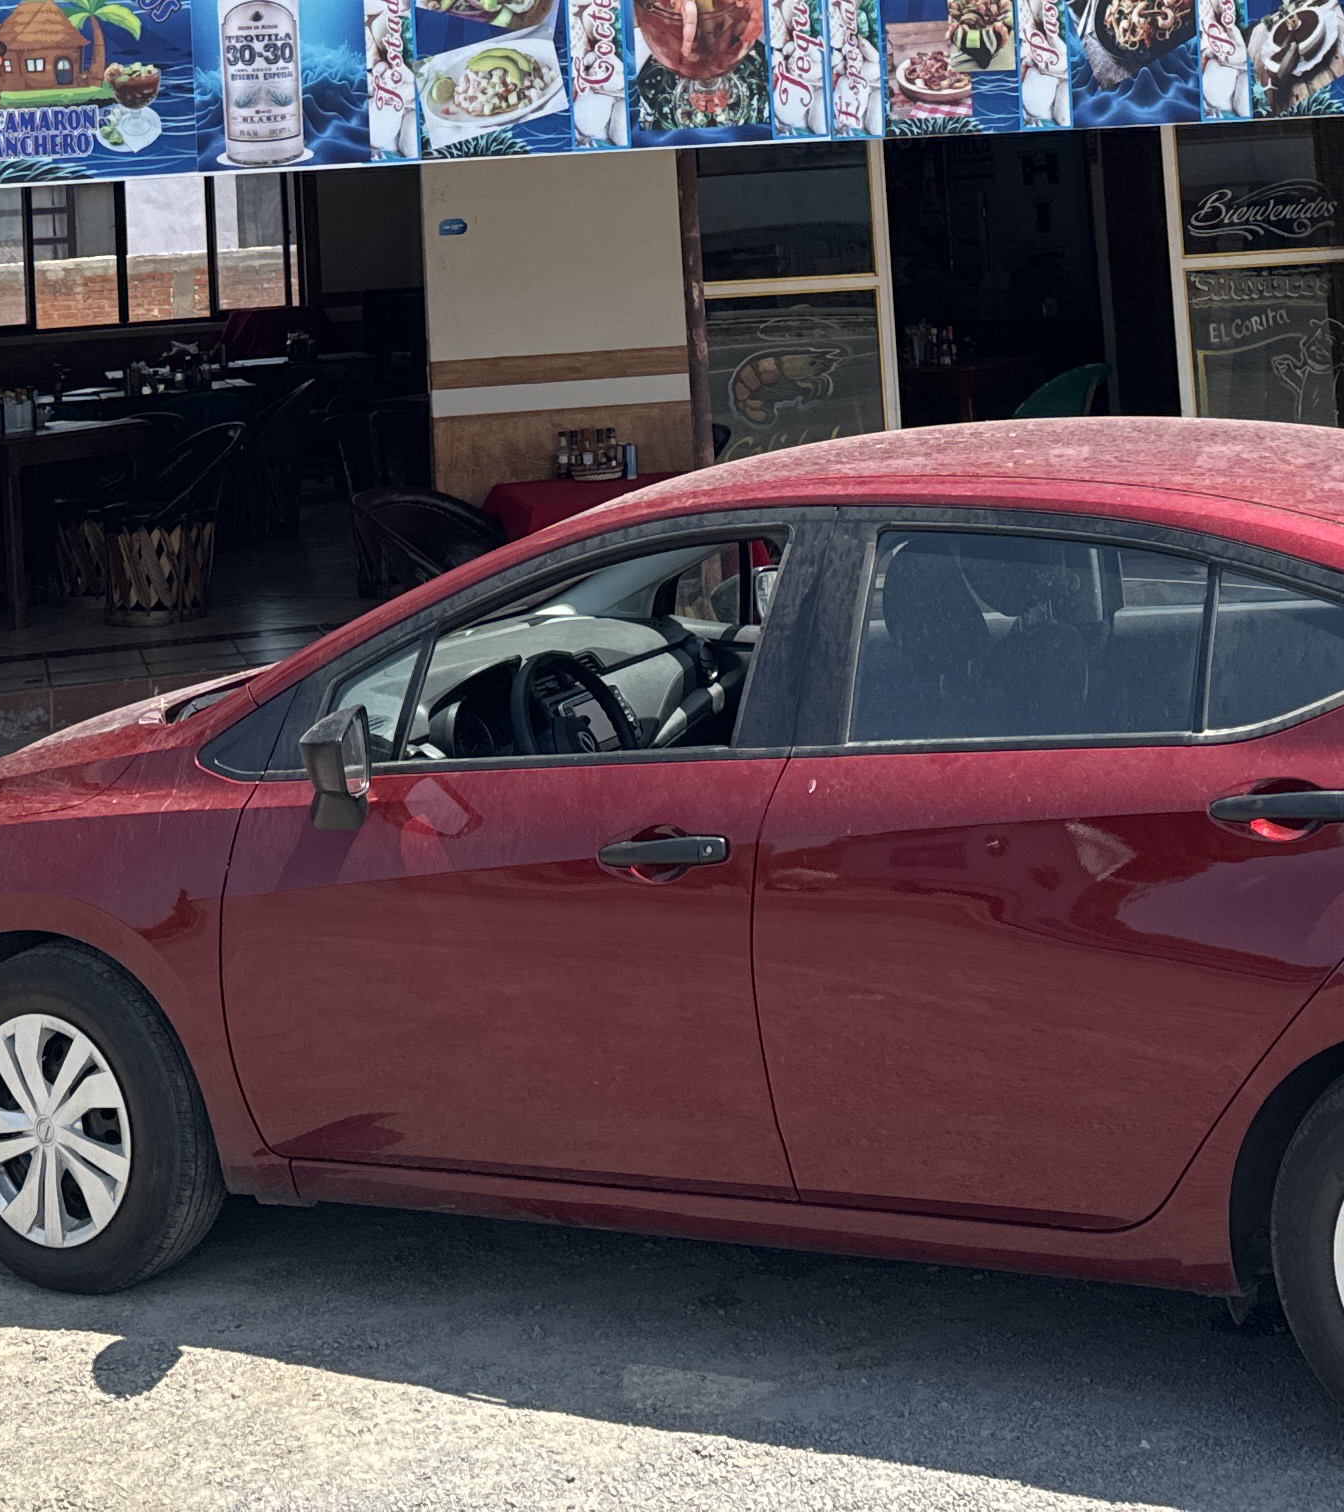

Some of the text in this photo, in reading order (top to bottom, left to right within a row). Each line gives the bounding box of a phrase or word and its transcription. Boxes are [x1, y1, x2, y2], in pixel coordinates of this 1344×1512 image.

[226, 32, 292, 44] TEQUILA
[227, 43, 293, 66] 30-30
[1190, 188, 1338, 226] Bienvenidos
